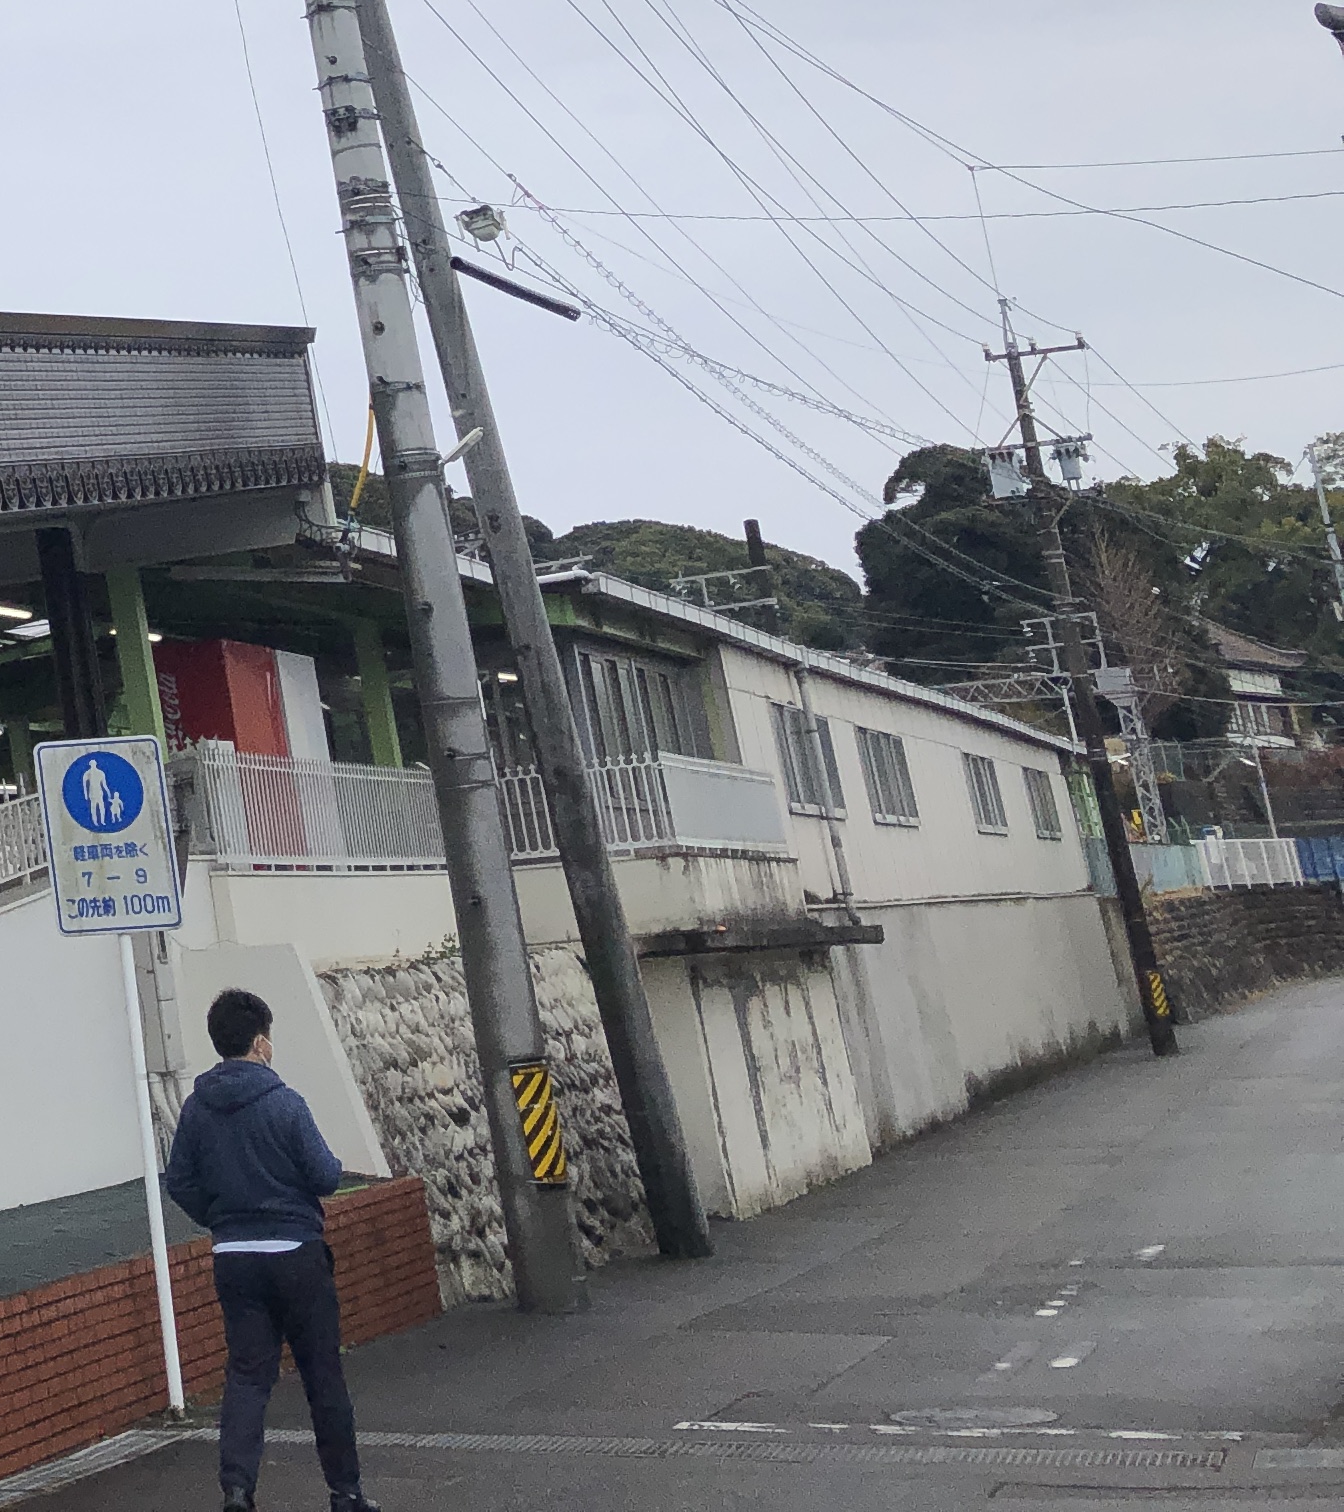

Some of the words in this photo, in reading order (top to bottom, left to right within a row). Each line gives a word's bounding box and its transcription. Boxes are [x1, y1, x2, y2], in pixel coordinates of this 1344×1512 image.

[73, 841, 149, 861] 軽車両を除く
[81, 871, 93, 887] 7
[135, 867, 148, 884] 9
[66, 895, 117, 919] この先約
[123, 893, 172, 915] 100m
